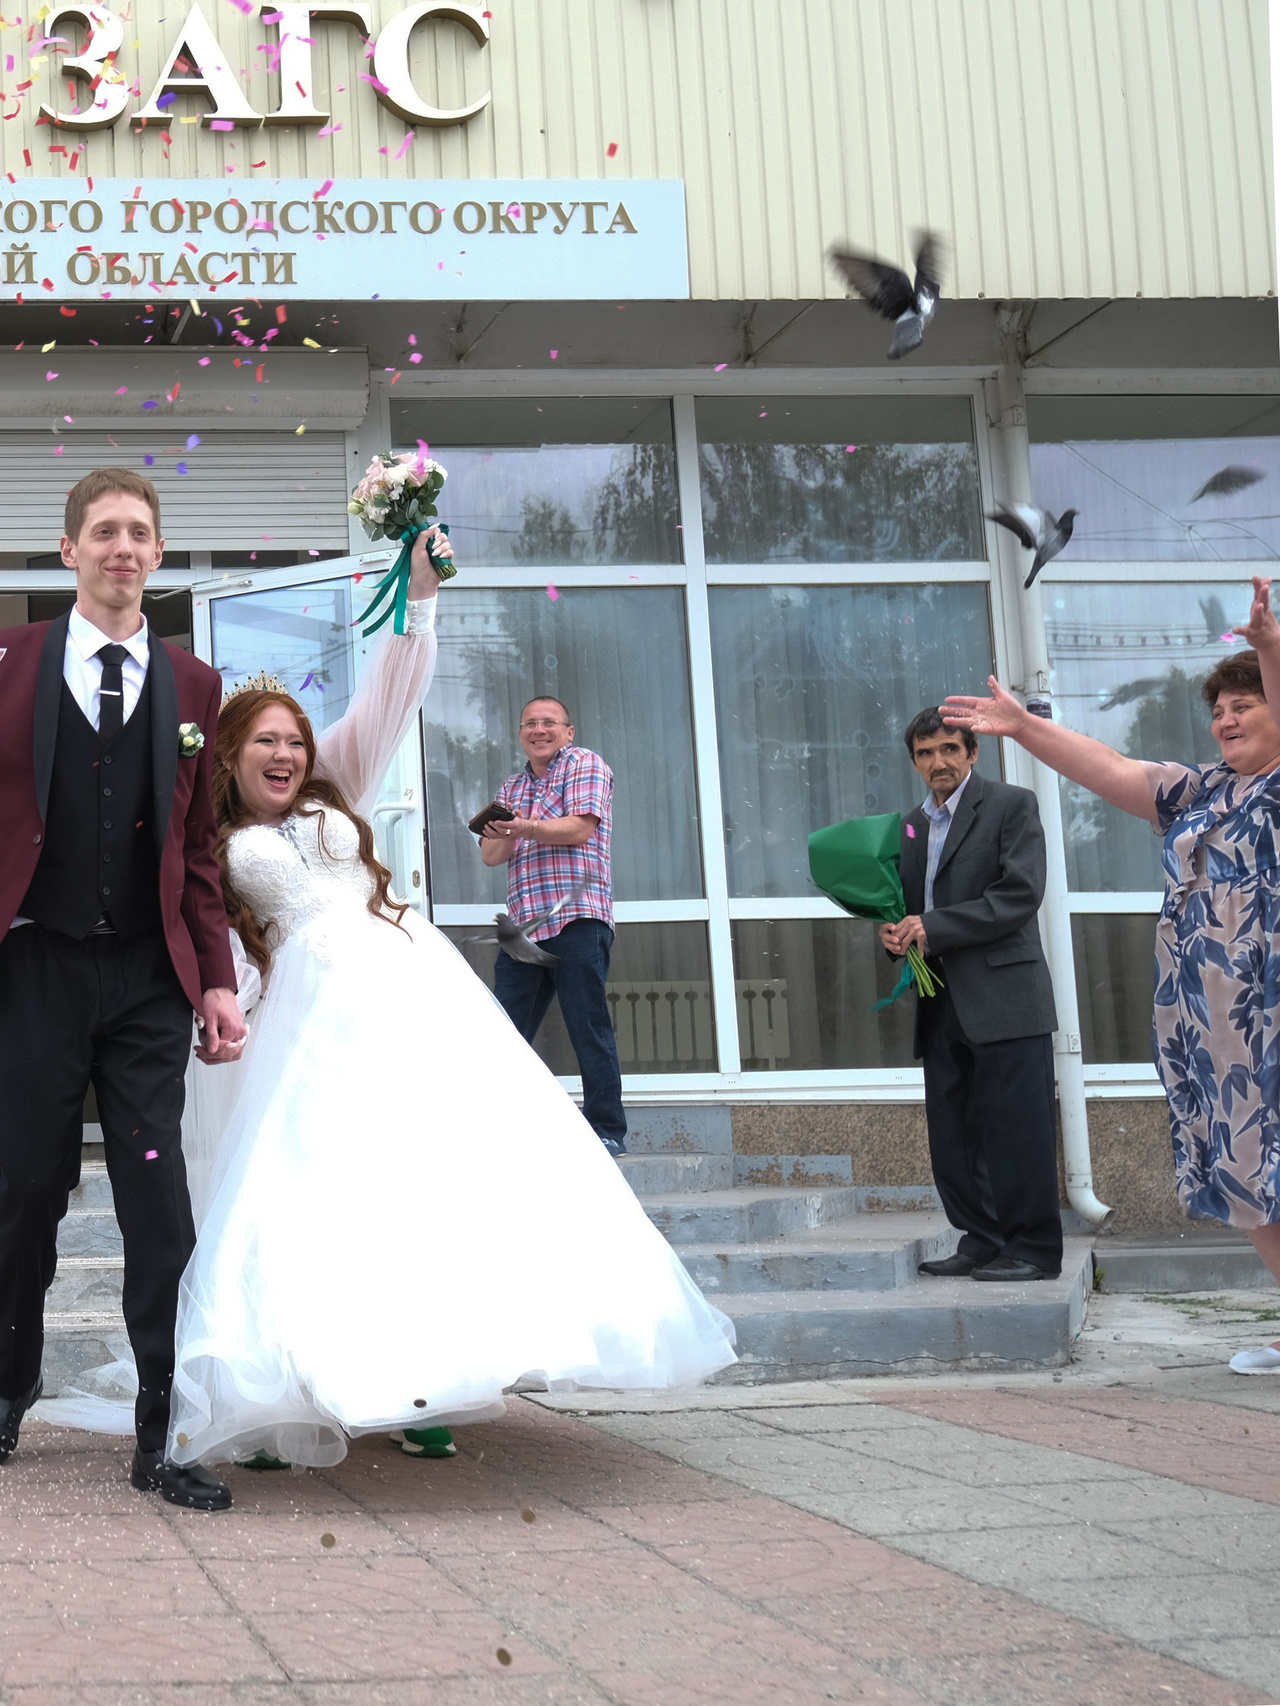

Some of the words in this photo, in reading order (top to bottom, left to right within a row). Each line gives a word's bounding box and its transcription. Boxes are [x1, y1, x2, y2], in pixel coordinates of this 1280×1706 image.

[37, 0, 491, 132] ЗАГС
[120, 199, 443, 241] ГОРОДСКОГО
[453, 201, 637, 235] ОКРУГА
[66, 250, 298, 286] ОБЛАСТИ
